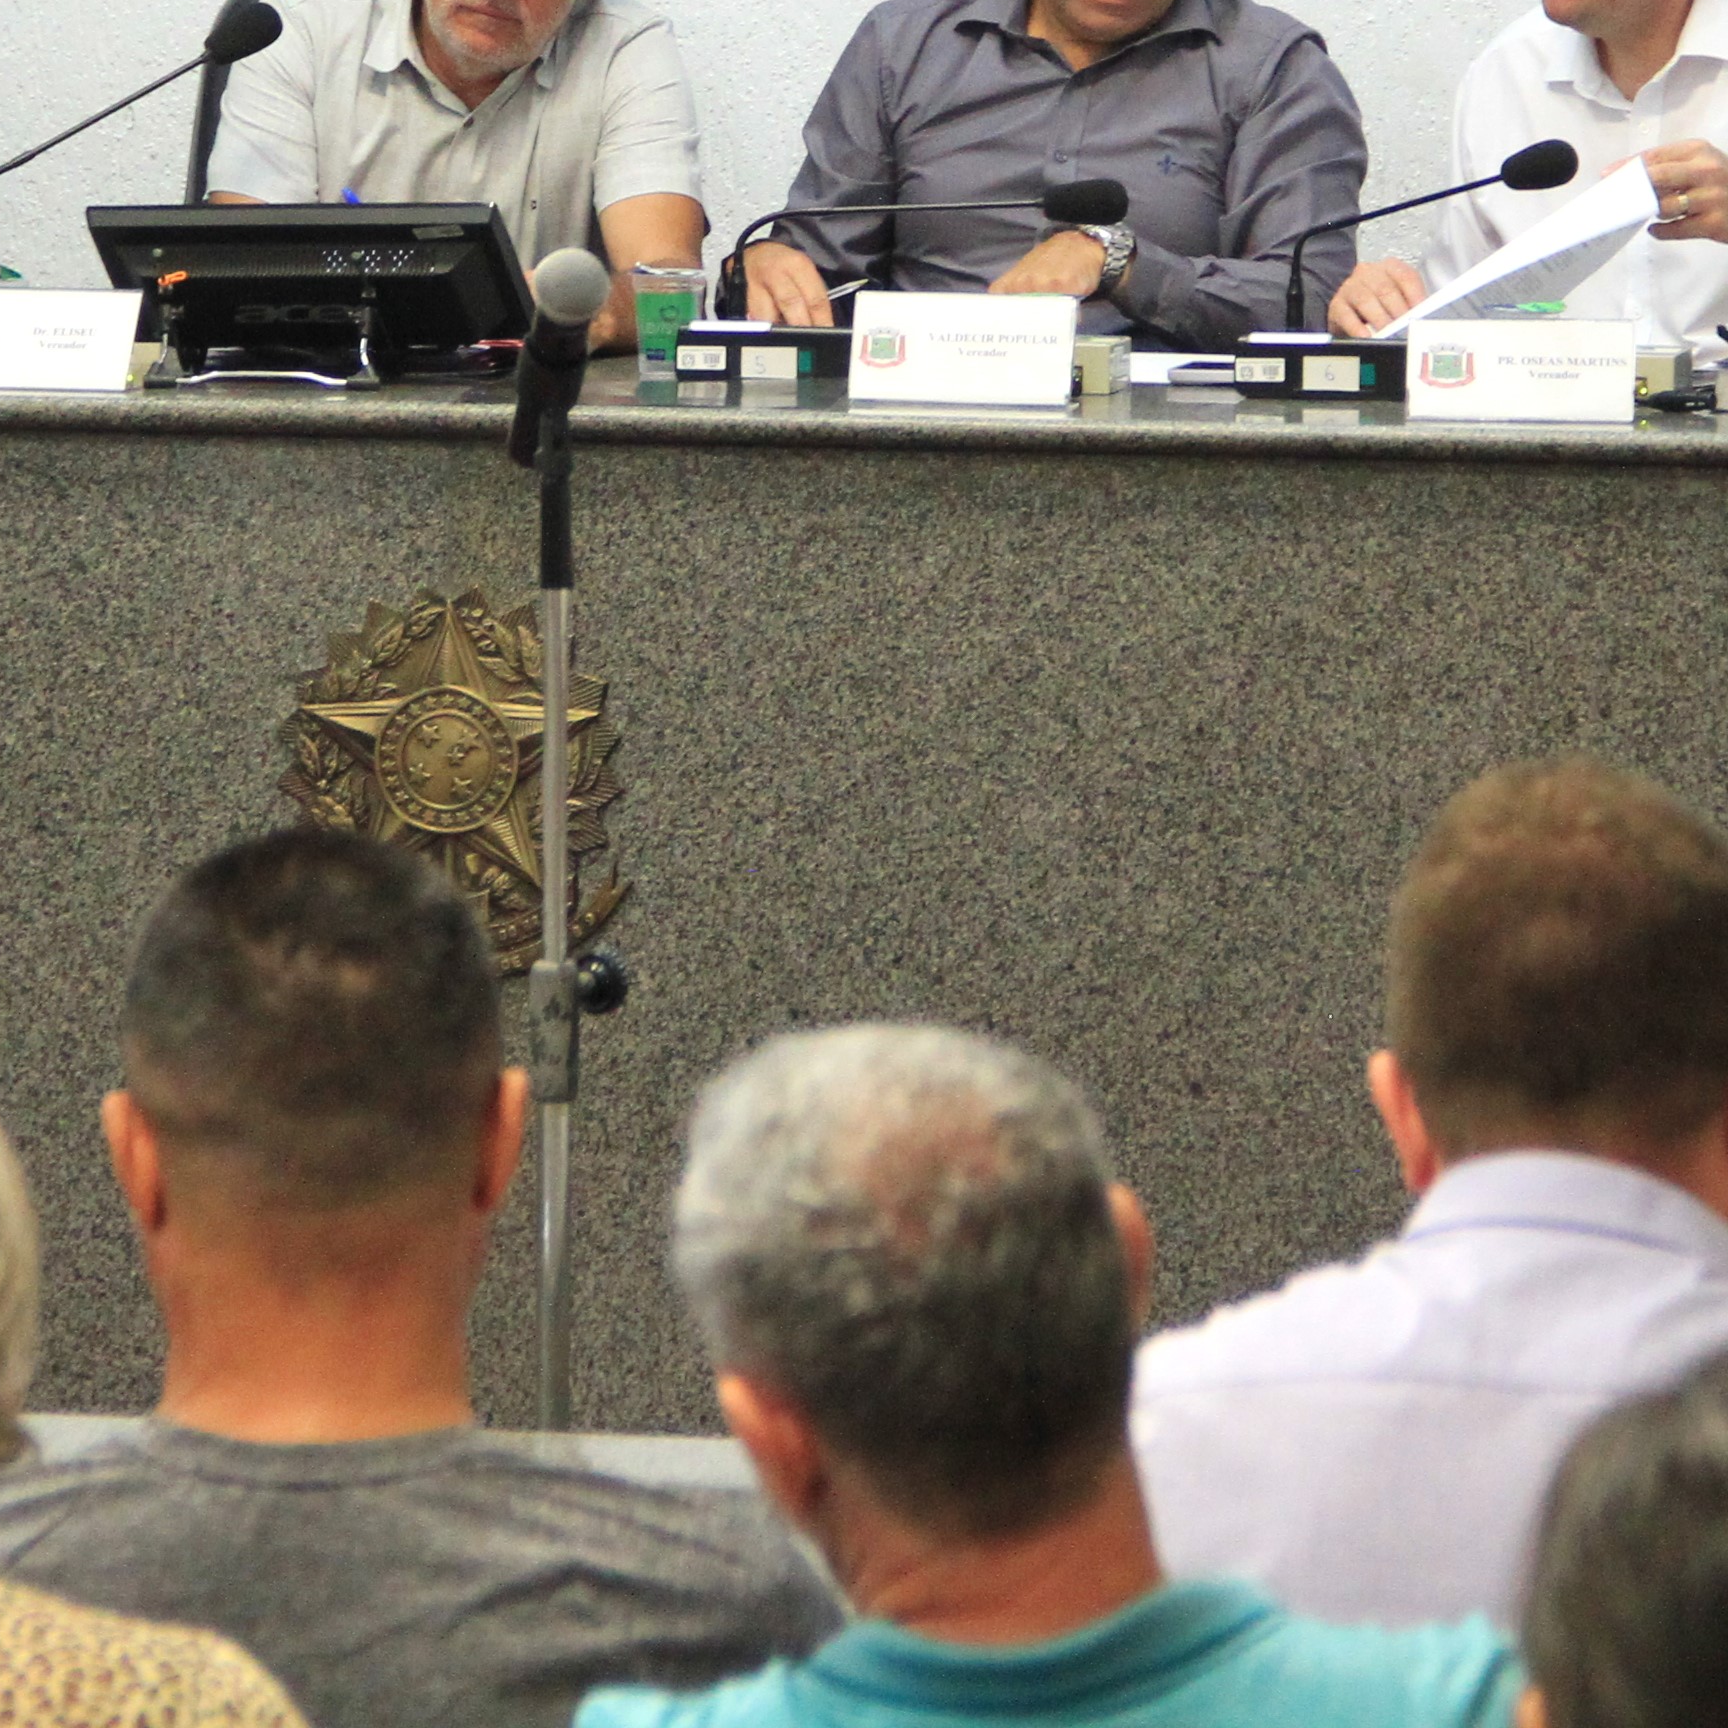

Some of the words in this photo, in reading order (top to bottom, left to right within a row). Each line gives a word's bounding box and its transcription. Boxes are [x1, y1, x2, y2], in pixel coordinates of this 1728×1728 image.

[928, 332, 995, 343] VALDECIR
[998, 334, 1058, 345] POPULAR
[957, 347, 1009, 357] Vereador
[1521, 356, 1564, 366] OSEAS
[1567, 357, 1628, 367] MARTINS
[1529, 370, 1581, 379] Vereador
